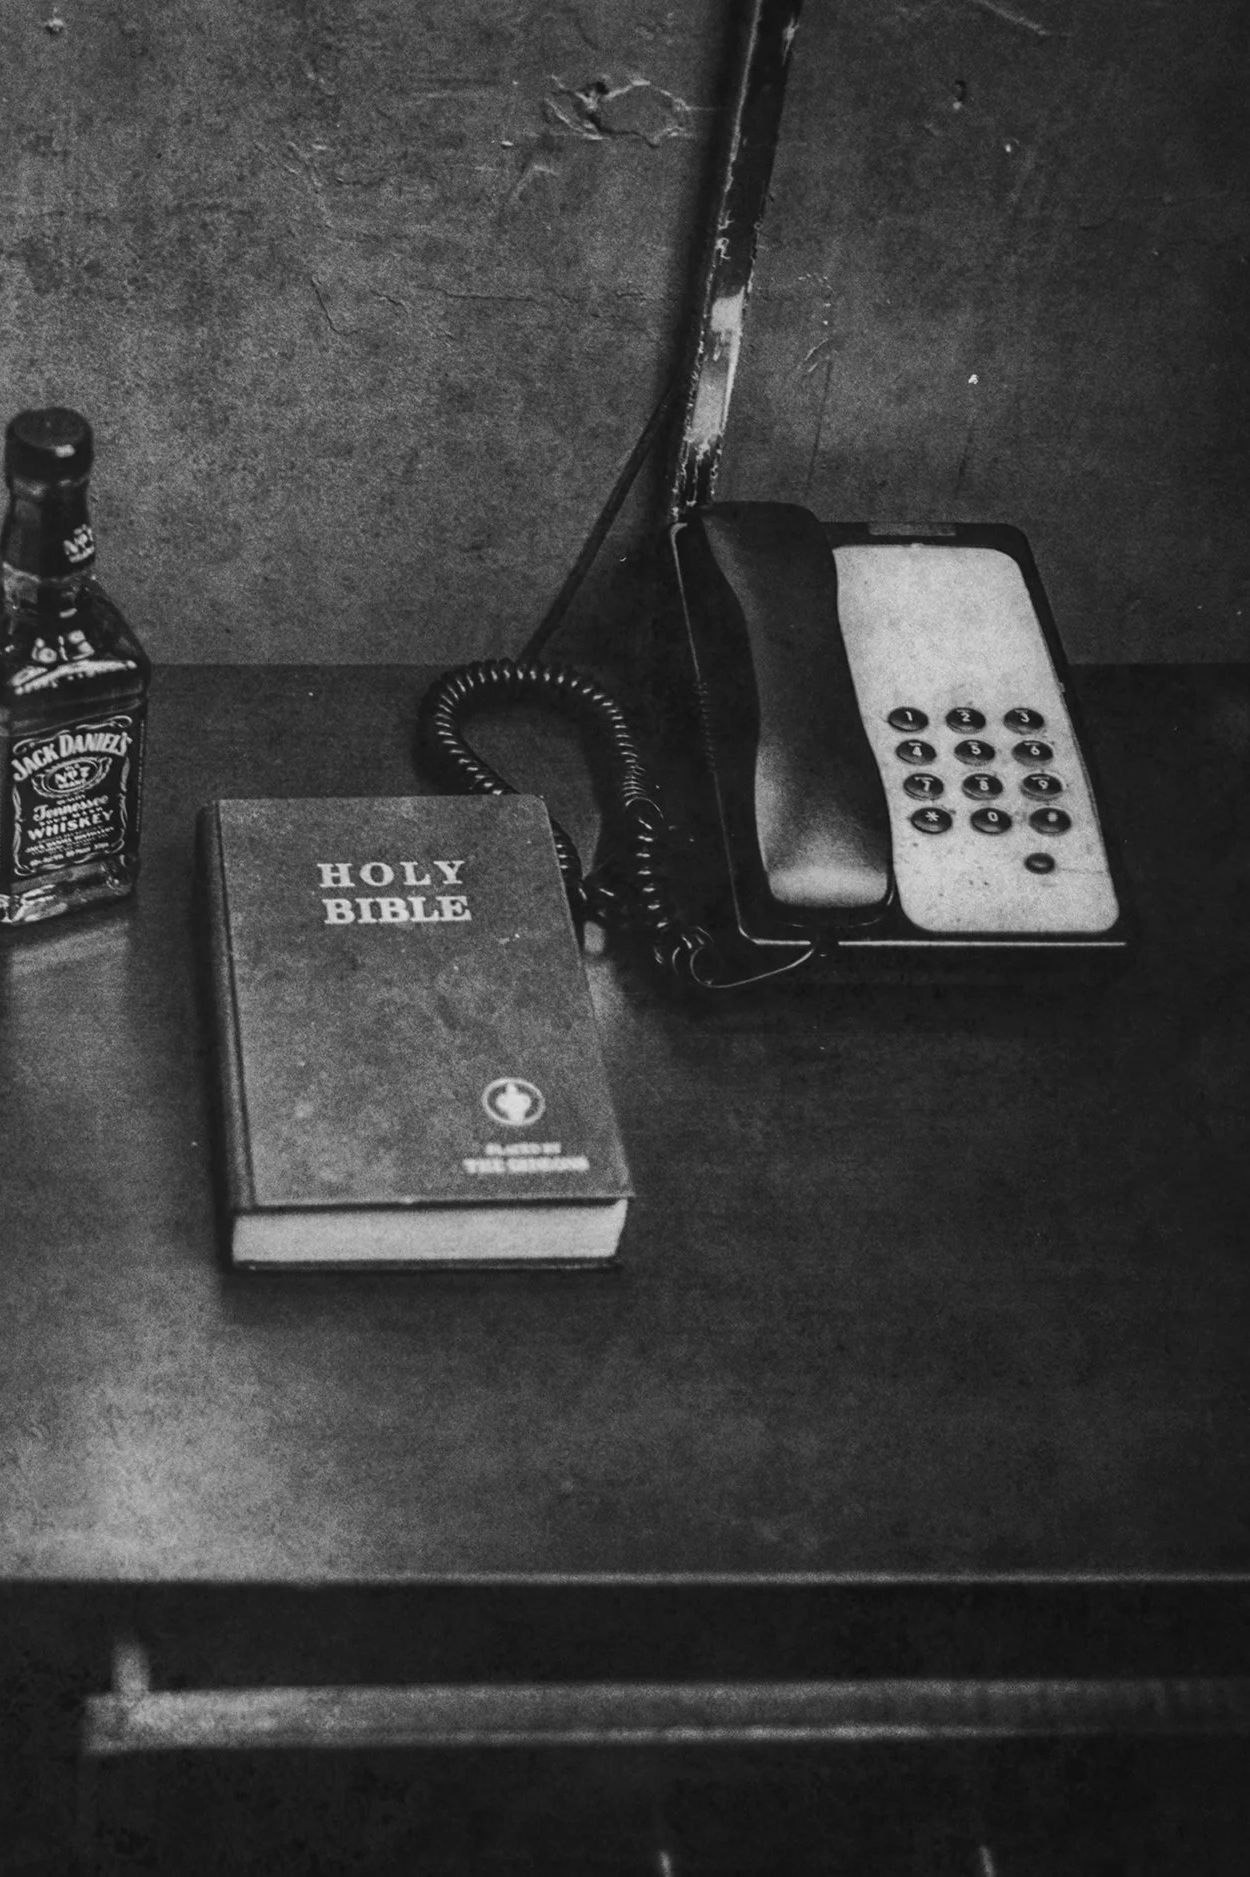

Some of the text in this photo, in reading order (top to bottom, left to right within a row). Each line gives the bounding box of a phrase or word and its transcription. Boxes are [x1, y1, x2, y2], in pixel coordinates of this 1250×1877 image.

[905, 711, 913, 721] 1
[960, 711, 971, 722] 2
[1019, 711, 1030, 723] 3
[11, 743, 60, 781] JACK
[970, 745, 981, 755] 5
[1030, 745, 1040, 756] 6
[979, 780, 989, 791] 8
[1038, 779, 1049, 789] 9
[27, 809, 114, 840] WHISKEY
[316, 860, 465, 888] HOLY
[321, 896, 472, 924] BIBLE
